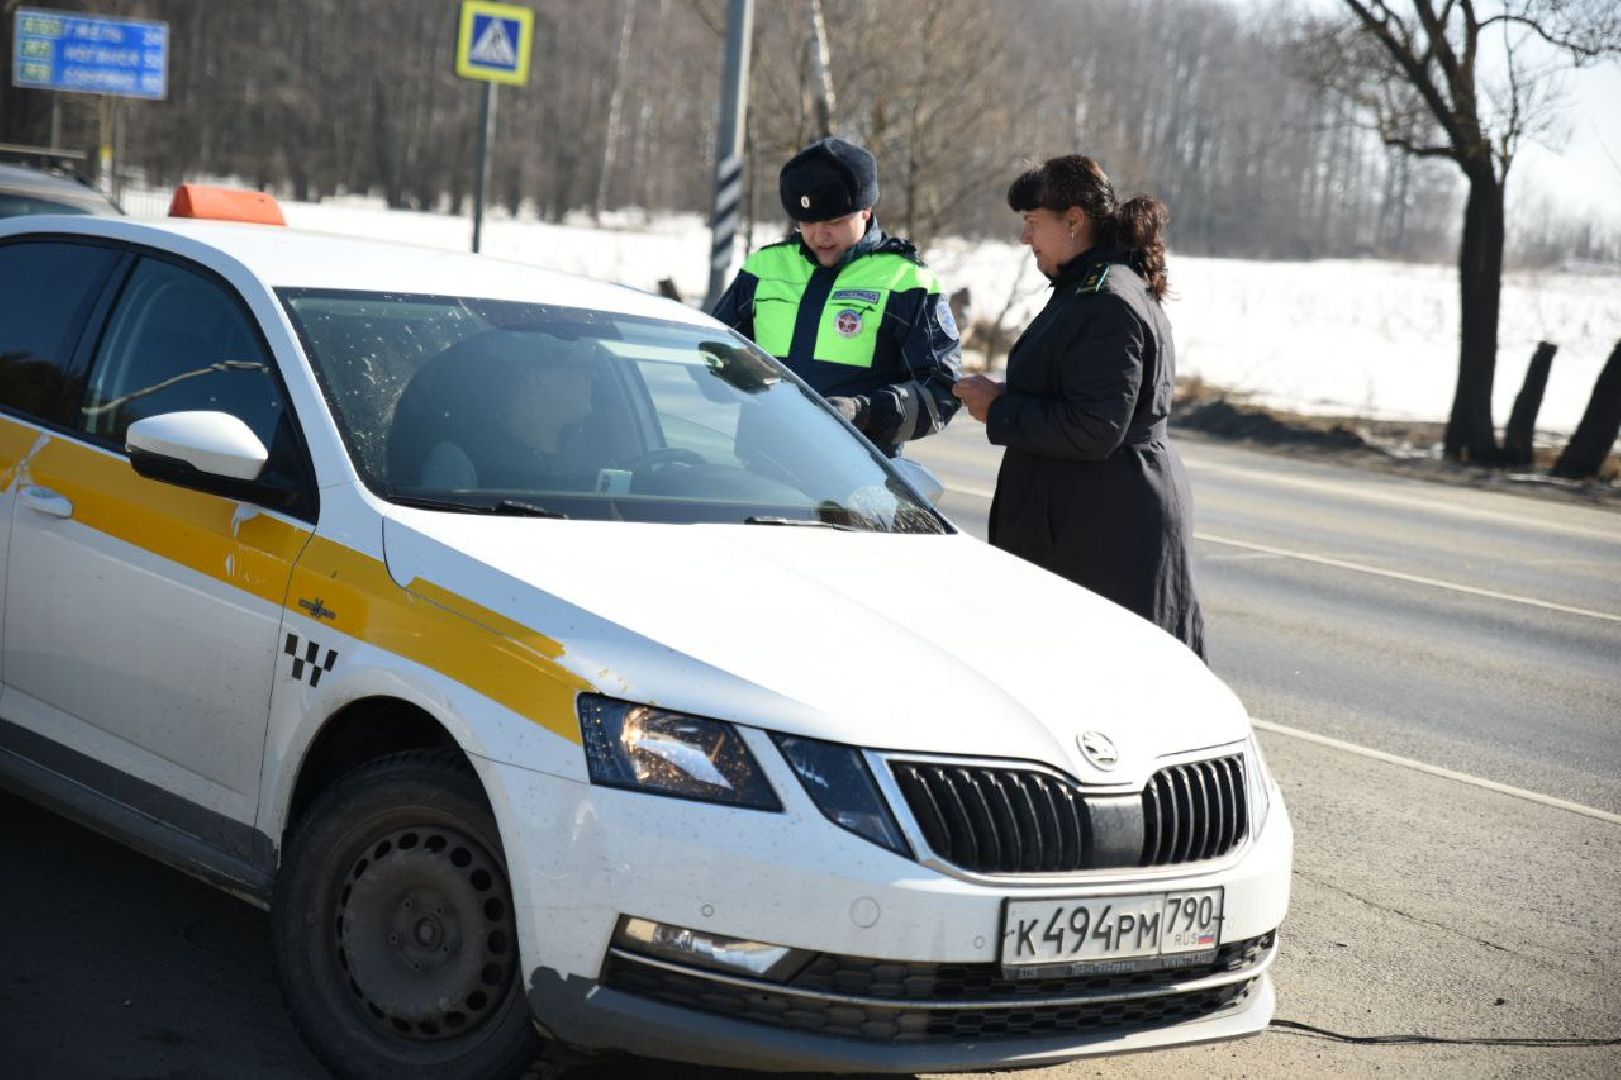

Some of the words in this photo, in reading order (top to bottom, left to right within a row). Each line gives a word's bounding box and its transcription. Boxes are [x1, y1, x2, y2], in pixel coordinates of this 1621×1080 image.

[1015, 905, 1161, 956] К494РМ
[1167, 895, 1213, 934] 790
[1175, 932, 1197, 947] RUS
